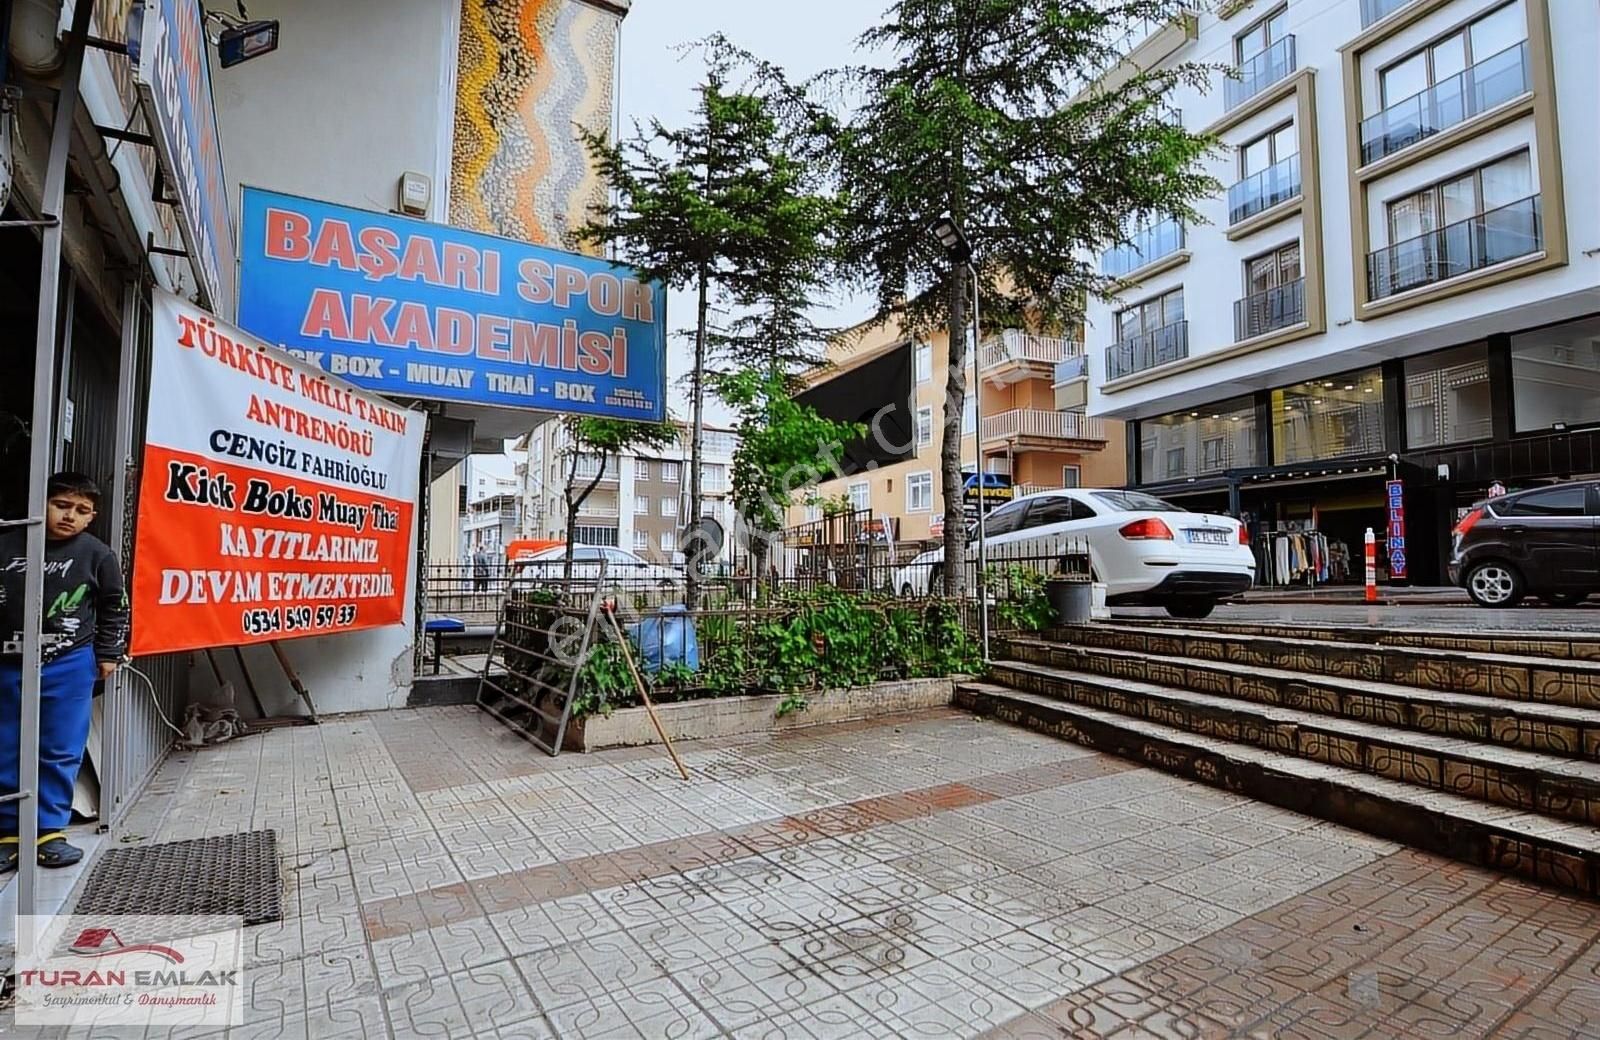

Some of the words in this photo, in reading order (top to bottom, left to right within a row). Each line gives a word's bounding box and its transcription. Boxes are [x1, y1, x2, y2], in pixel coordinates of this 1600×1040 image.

[265, 208, 500, 296] BAŞARI
[516, 257, 655, 322] SPOR
[300, 287, 627, 379] AKADEMİSİ
[177, 314, 296, 393] TÜRKİYE
[299, 374, 353, 416] MİLLİ
[330, 353, 384, 378] BOX
[407, 362, 475, 388] MUAY
[554, 381, 596, 403] BOX
[246, 394, 374, 457] ANTRENÖRÜ
[209, 429, 297, 470] CENGİZ
[302, 452, 388, 490] FAHRİOĞLU
[165, 462, 236, 510] Kick
[243, 478, 314, 520] Boks
[317, 492, 369, 533] Muay
[220, 523, 379, 563] KAYITLARIMIZ
[159, 569, 262, 604] DEVAM
[243, 606, 281, 635] 0534
[285, 605, 312, 631] 549
[315, 605, 336, 628] 59
[336, 604, 356, 626] 33
